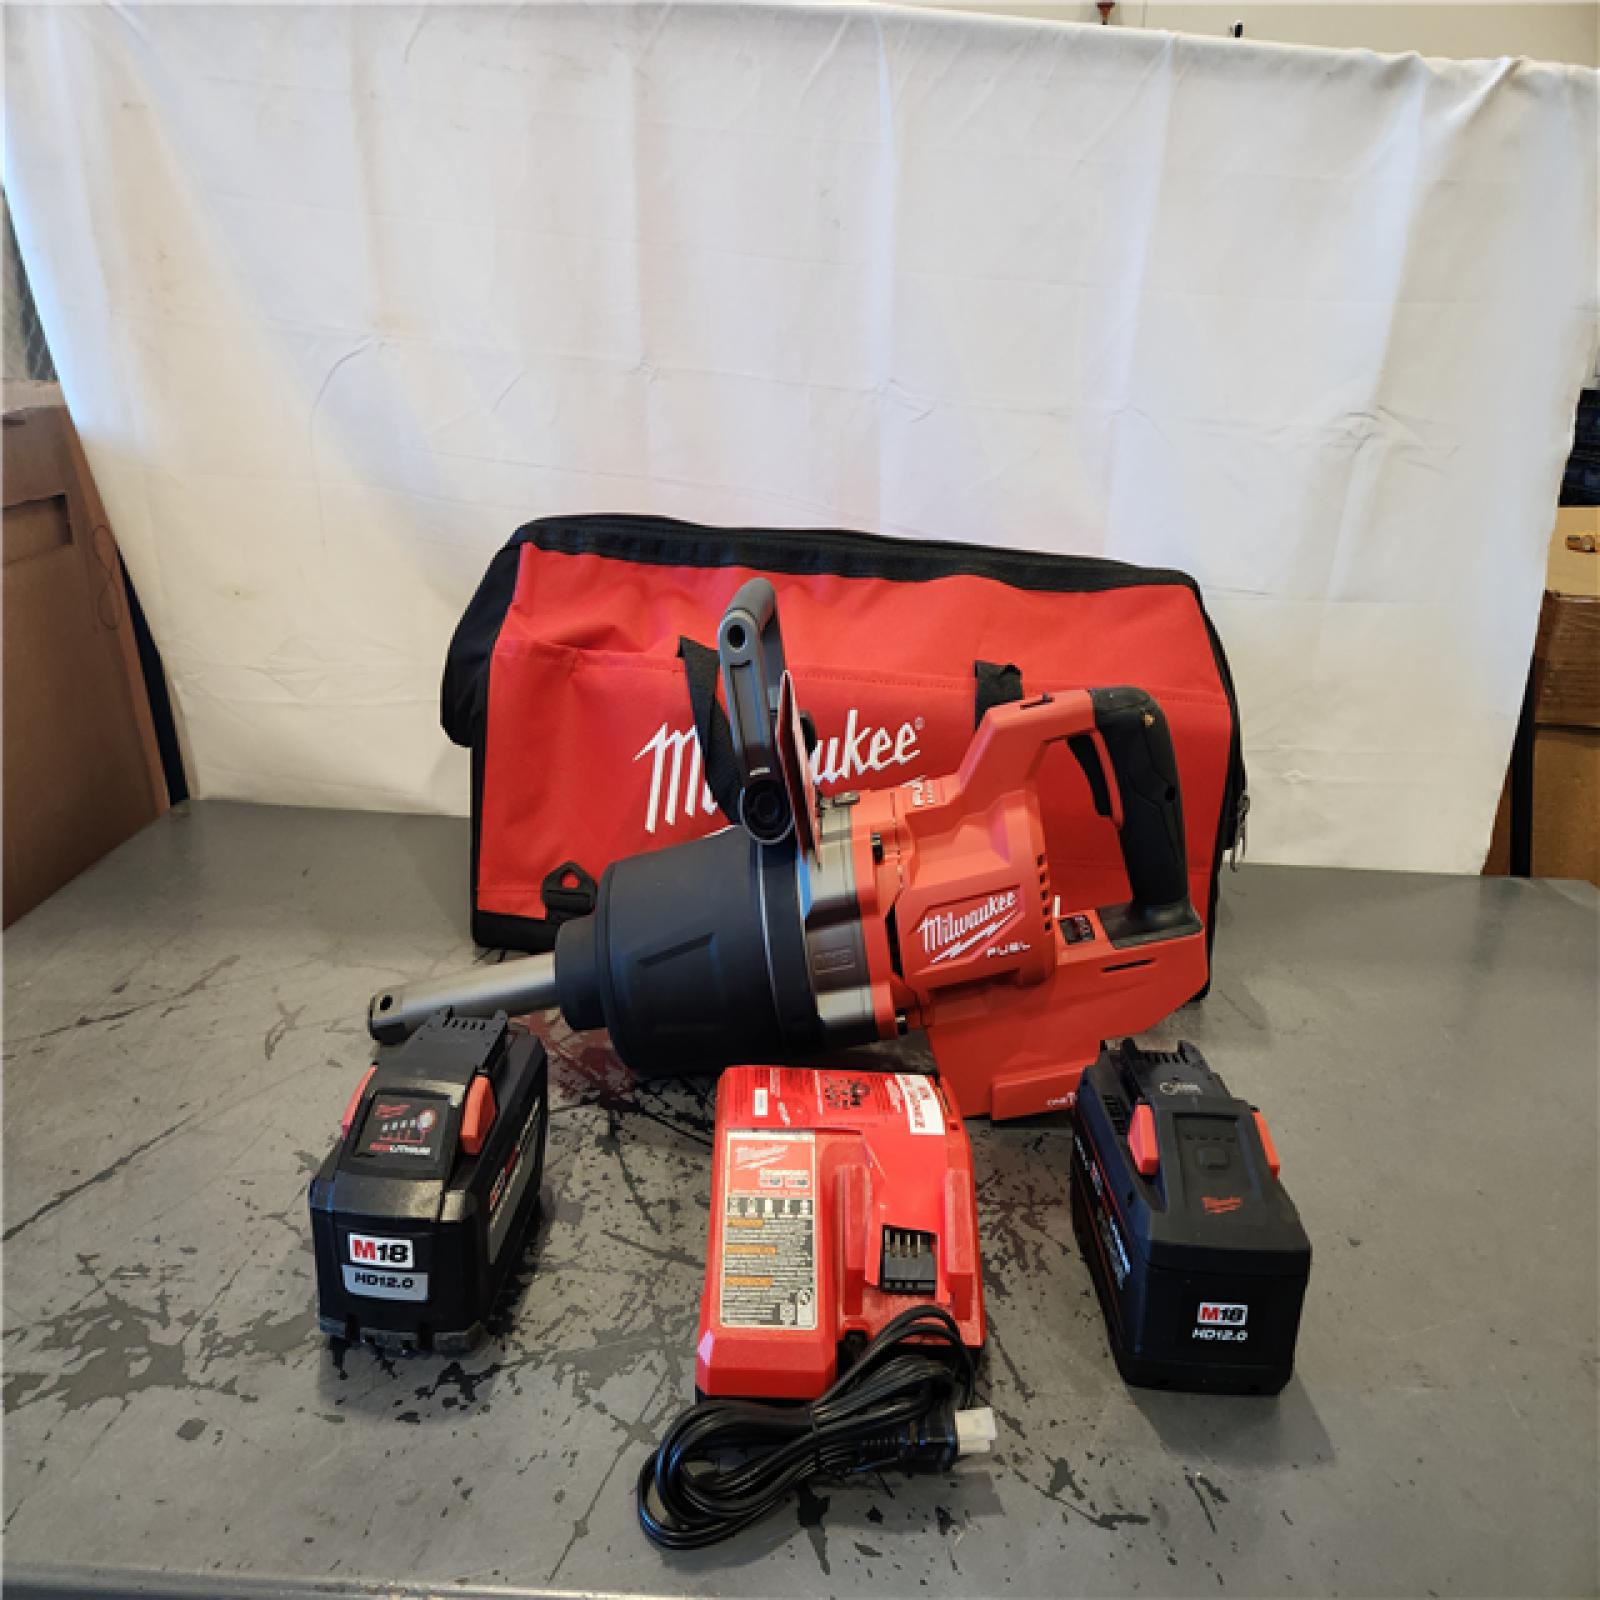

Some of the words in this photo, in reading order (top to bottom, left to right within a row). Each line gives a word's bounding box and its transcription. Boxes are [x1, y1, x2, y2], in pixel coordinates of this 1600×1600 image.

[917, 890, 1016, 954] Milwaukee
[352, 1239, 409, 1263] M18
[354, 1271, 414, 1290] HD12.0
